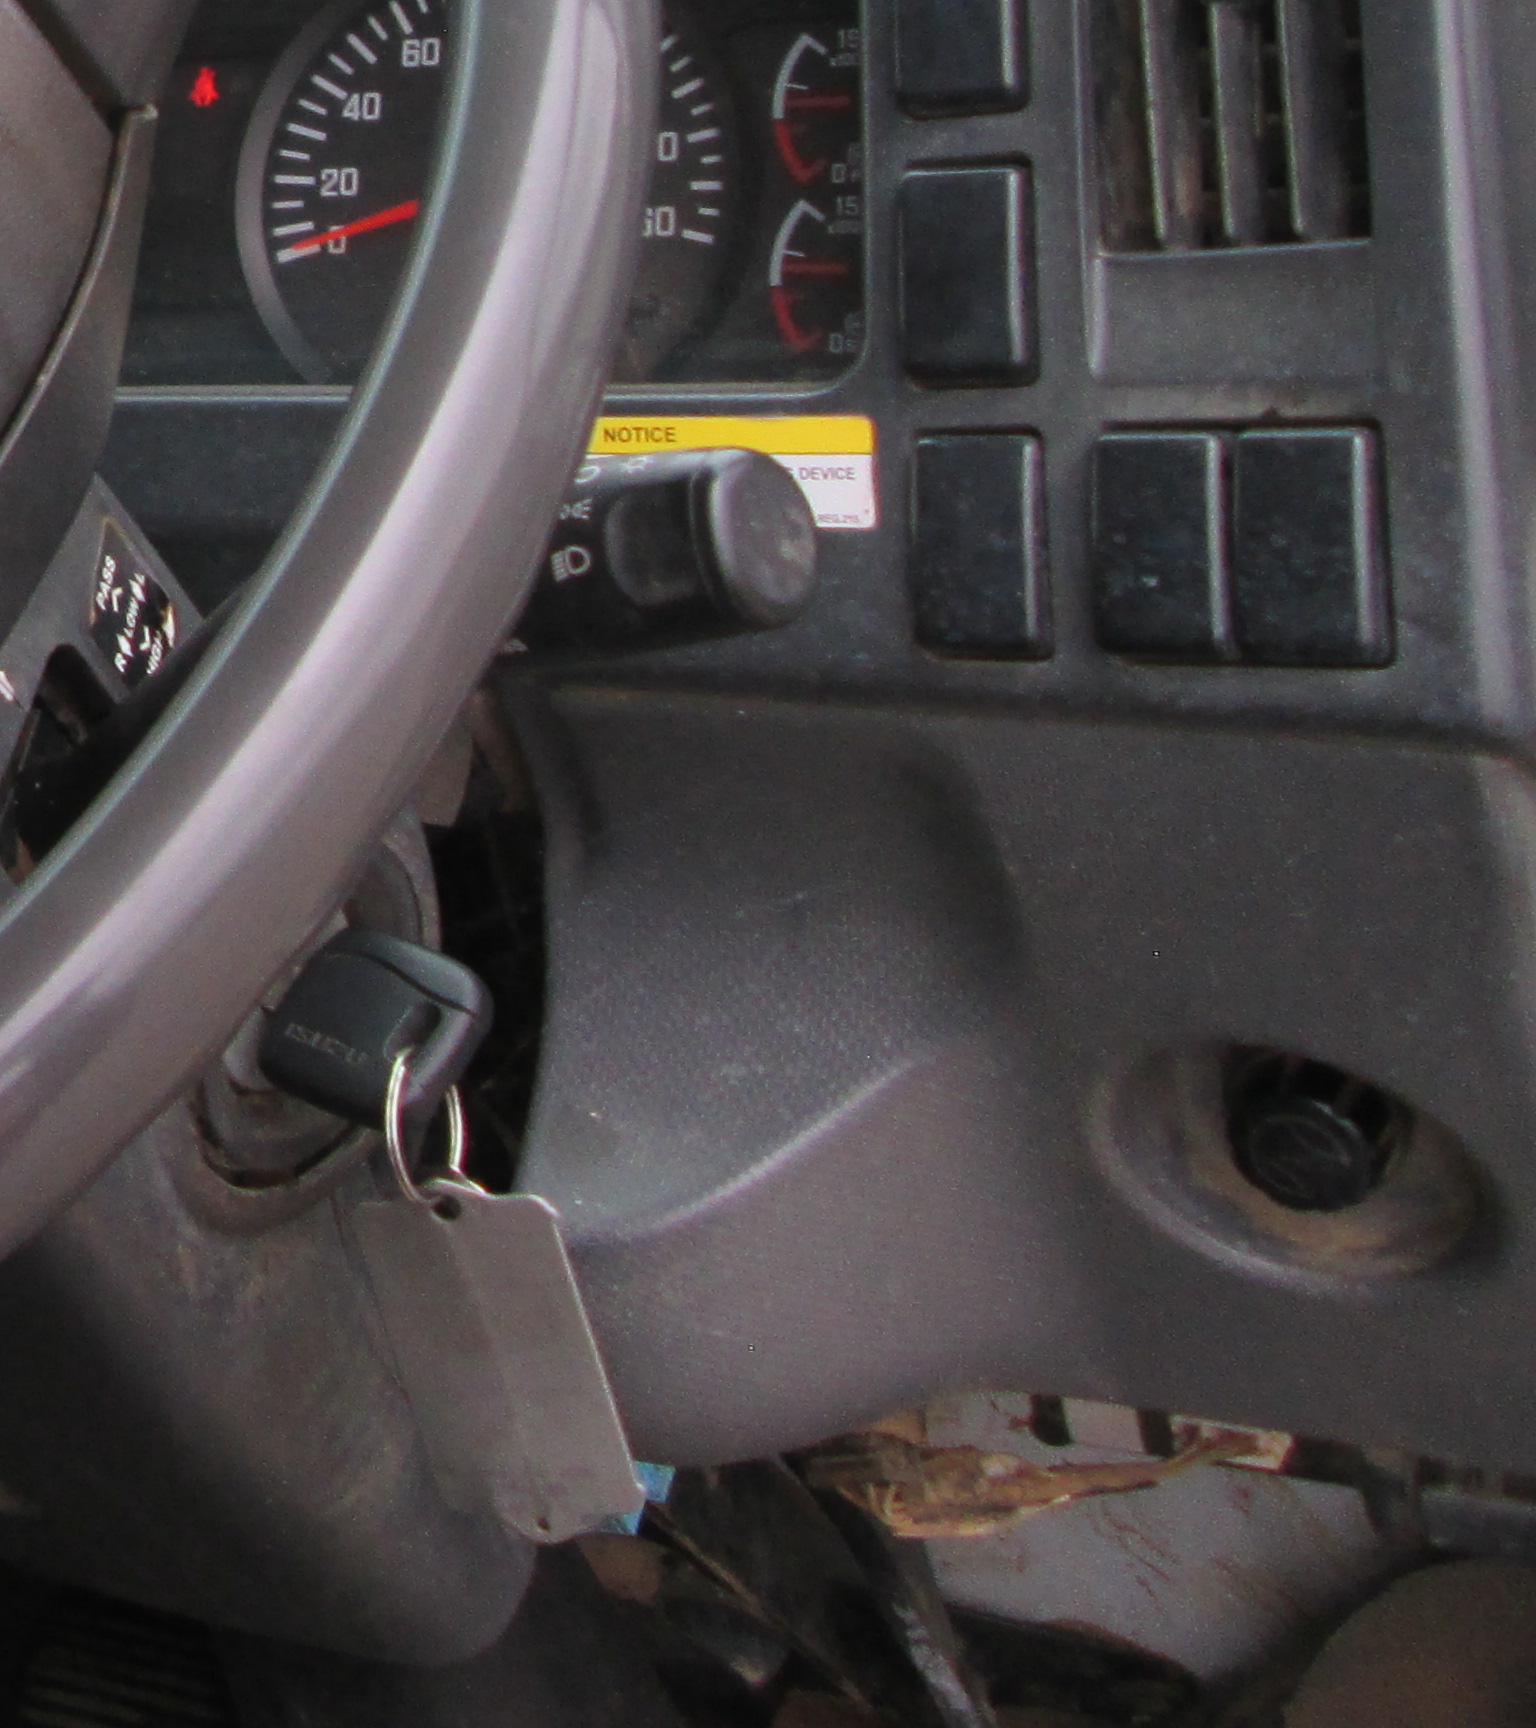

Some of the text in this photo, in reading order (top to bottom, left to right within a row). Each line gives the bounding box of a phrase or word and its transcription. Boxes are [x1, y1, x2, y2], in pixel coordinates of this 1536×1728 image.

[402, 37, 441, 67] 60
[342, 92, 382, 121] 40
[320, 167, 359, 197] 20
[603, 426, 677, 443] NOTICE
[799, 467, 856, 480] DEVICE
[95, 555, 116, 611] PASS
[285, 1022, 368, 1067] ISUZU
